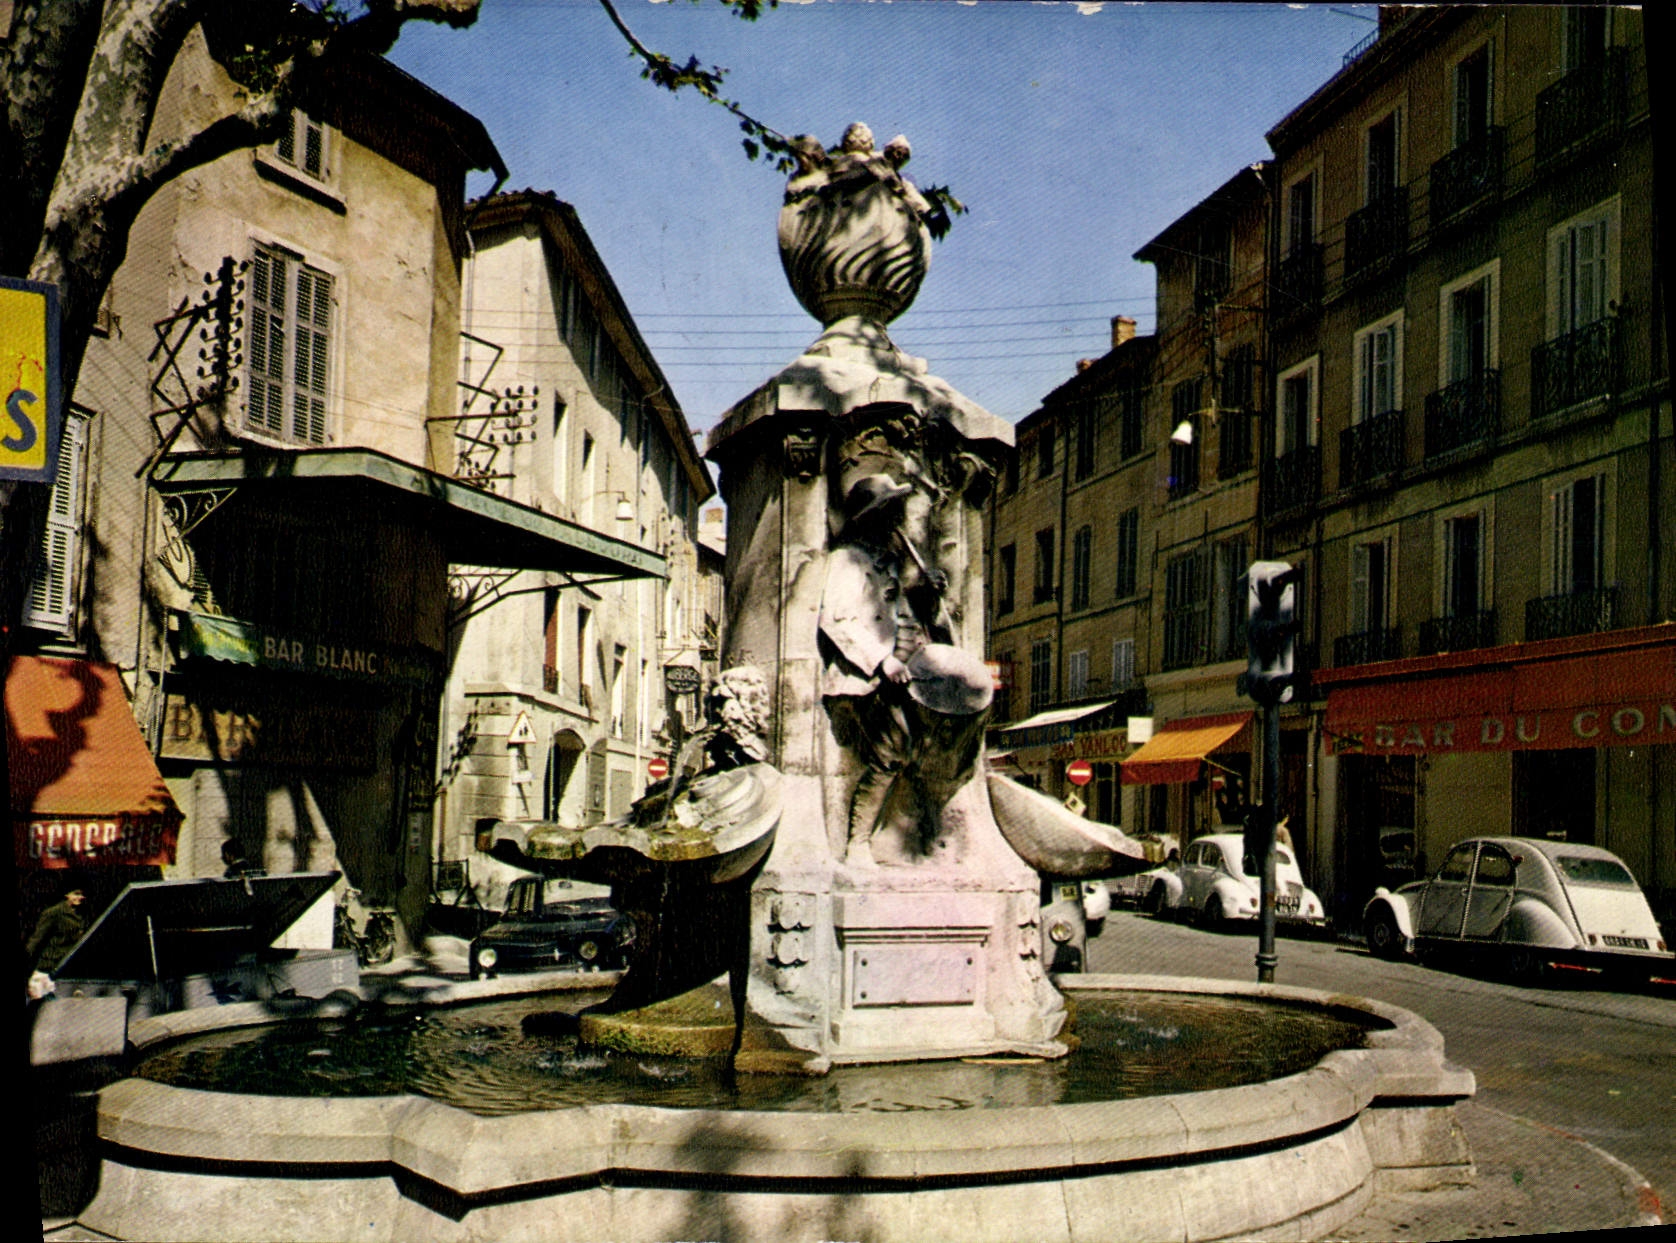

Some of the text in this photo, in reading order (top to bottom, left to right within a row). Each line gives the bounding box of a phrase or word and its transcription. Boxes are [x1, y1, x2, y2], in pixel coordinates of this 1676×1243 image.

[2, 390, 37, 452] S
[263, 635, 304, 665] BAR
[315, 644, 378, 675] BLANC
[1375, 720, 1455, 748] BAR
[1480, 713, 1541, 744] DU
